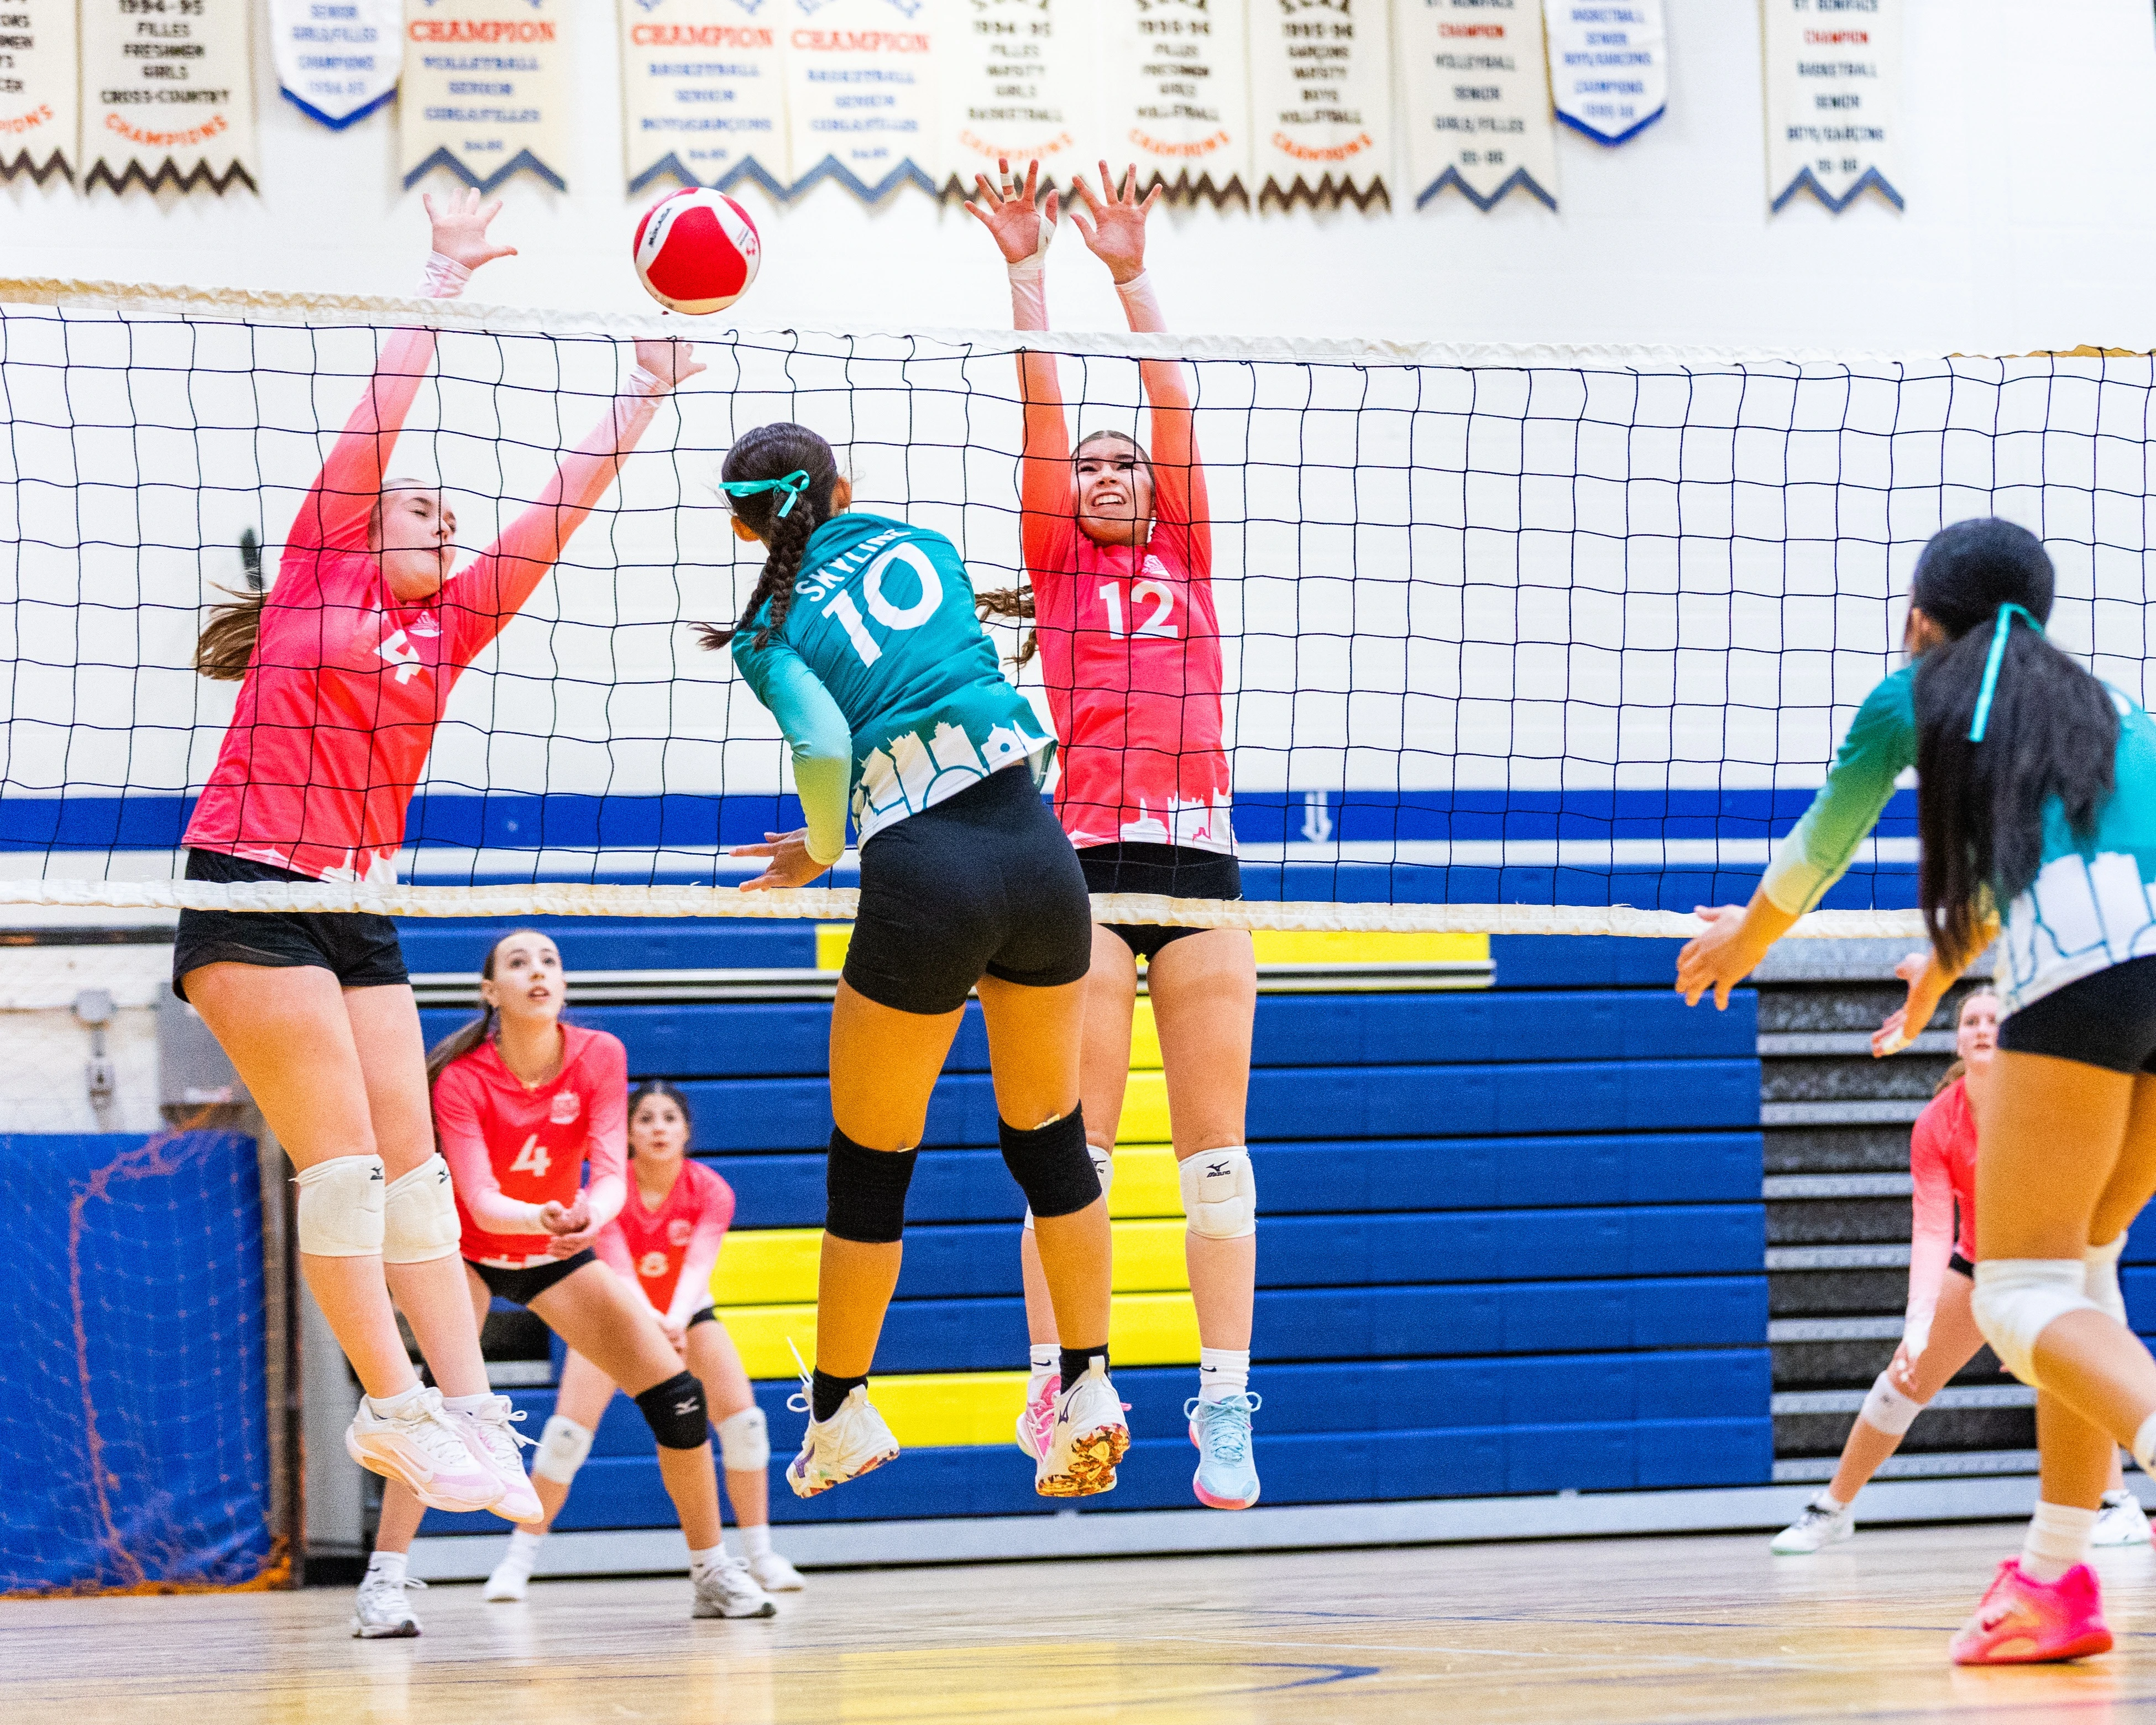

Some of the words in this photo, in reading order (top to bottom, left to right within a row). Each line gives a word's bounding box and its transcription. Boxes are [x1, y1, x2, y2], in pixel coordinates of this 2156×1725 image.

[137, 22, 190, 38] FILLES
[408, 20, 554, 42] CHAMPION
[631, 23, 772, 47] CHAMPION
[1438, 23, 1505, 38] CHAMPION
[1804, 30, 1869, 44] CHAMPION
[791, 29, 929, 53] CHAMPION
[124, 44, 204, 58] FRESHMEN
[423, 56, 537, 70] VOLLEYBALL
[1436, 55, 1514, 70] VOLLEYBALL
[1797, 62, 1877, 77] BASKETBALL
[143, 66, 187, 79] GIRLS
[649, 64, 757, 76] BASKETBALL
[808, 70, 914, 83] BASKETBALL
[449, 82, 512, 95] SENIOR
[1456, 87, 1499, 100] SENIOR
[102, 90, 229, 103] CROSS-COUNTRY
[677, 90, 735, 102] SENIOR
[835, 96, 894, 108] SENIOR
[1817, 96, 1859, 108] SENIOR
[106, 113, 227, 146] CHAMPIONS
[795, 529, 911, 602] SKYLINE
[821, 542, 943, 668] 10
[1099, 580, 1178, 640] 12
[510, 1135, 551, 1177] 4
[1206, 1170, 1231, 1178] MIZUNO
